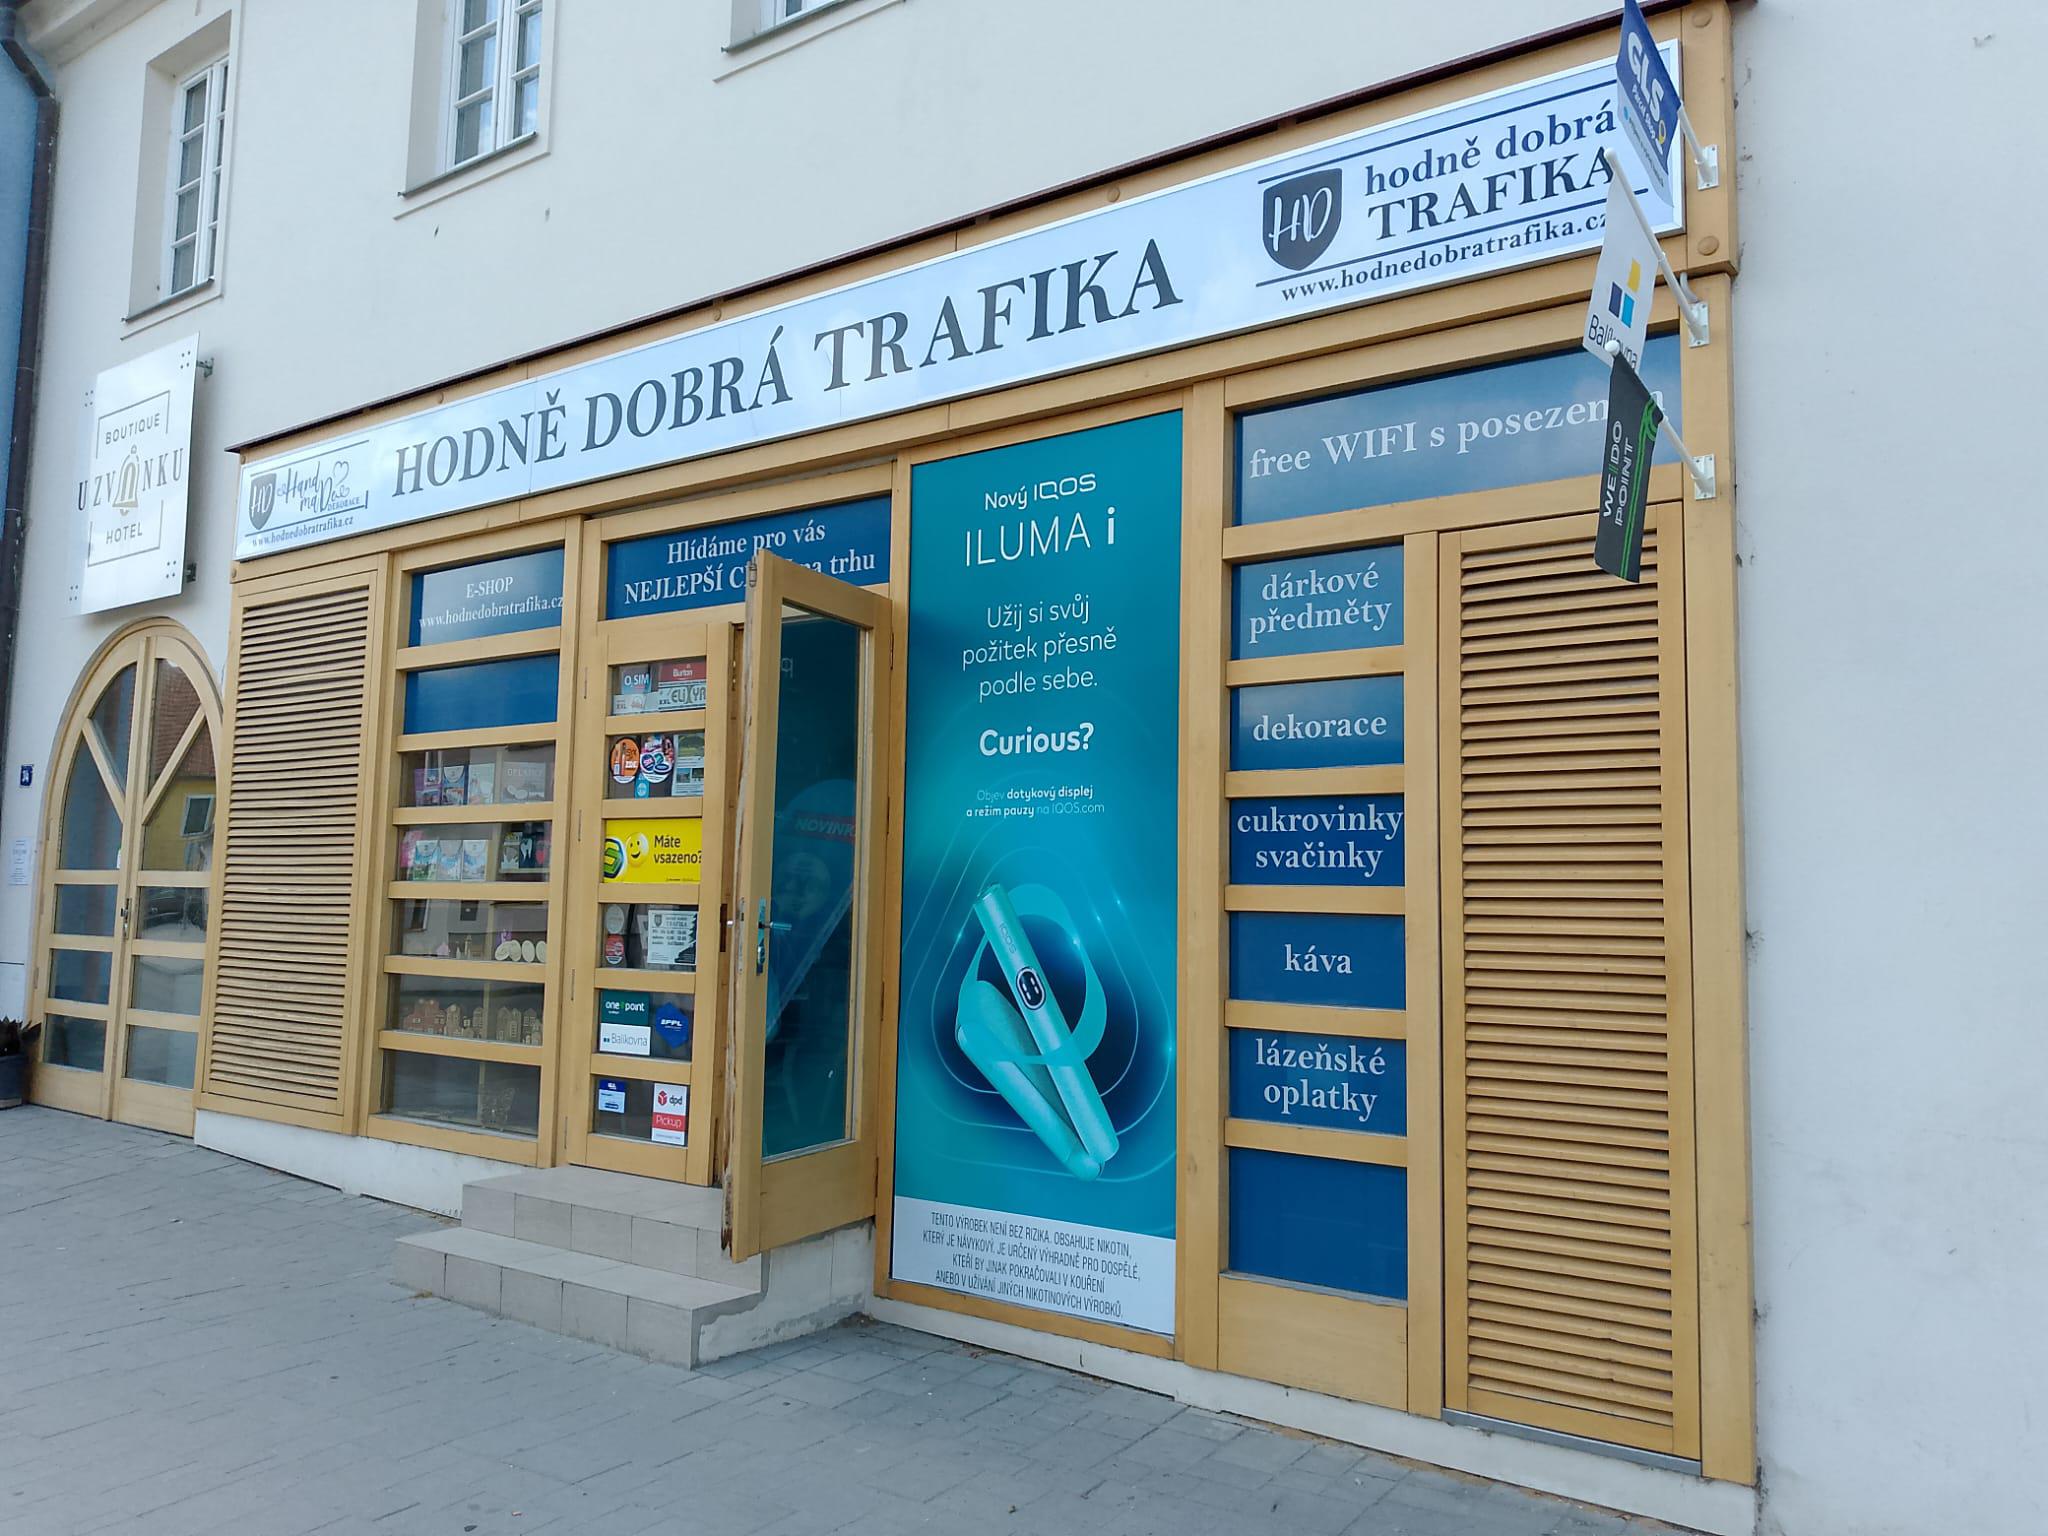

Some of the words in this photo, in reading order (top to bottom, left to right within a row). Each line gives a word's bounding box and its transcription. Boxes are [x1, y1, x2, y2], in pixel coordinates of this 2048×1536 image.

[1628, 31, 1664, 122] GLS
[1365, 137, 1481, 196] hodně
[1495, 99, 1616, 162] dobrá
[1368, 146, 1613, 240] TRAFIKA
[1281, 213, 1605, 301] www.hodnedobratrafika.cz
[392, 388, 566, 497] HODNĚ
[581, 325, 793, 452] DOBRÁ
[814, 238, 1183, 392] TRAFIKA
[105, 412, 160, 445] BOUTIQUE
[1249, 448, 1311, 479] free
[1322, 422, 1416, 465] WIFI
[1430, 426, 1445, 448] s
[1457, 390, 1665, 455] posezen
[985, 485, 1028, 511] Nový
[1034, 473, 1097, 501] IQOS
[1615, 437, 1633, 526] POINT
[105, 521, 143, 545] HOTEL
[667, 536, 748, 565] Hlídáme
[753, 530, 786, 555] pro
[792, 519, 826, 543] vás
[966, 512, 1091, 567] ILUMA
[1107, 506, 1116, 545] i
[466, 576, 514, 599] E-SHOP
[624, 562, 722, 605] NEJLEPŠÍ
[830, 549, 876, 575] trhu
[1261, 562, 1380, 601] dárkové
[418, 595, 564, 628] www.hodnedobratrafika.cz
[987, 603, 1023, 632] Užij
[1028, 601, 1043, 623] si
[1049, 593, 1090, 624] svůj
[1249, 599, 1392, 644] předměty
[962, 635, 1038, 672] požitek
[1044, 625, 1117, 663] přesně
[979, 670, 1036, 704] podle
[1042, 665, 1098, 691] sebe.
[979, 722, 1095, 757] Curious?
[1253, 713, 1387, 741] dekorace
[966, 808, 973, 817] a
[975, 805, 1002, 817] režim
[1003, 806, 1035, 819] pauzy
[1006, 786, 1056, 802] dotykový
[1057, 784, 1094, 800] displej
[654, 834, 681, 849] Máte
[1237, 803, 1404, 841] cukrovinky
[653, 850, 703, 865] vsazeno?
[1255, 840, 1384, 878] svačinky
[1284, 943, 1352, 974] káva
[625, 1002, 645, 1013] point
[1255, 1038, 1386, 1075] lázeňské
[669, 1095, 683, 1106] dpd
[1263, 1078, 1378, 1122] oplatky
[922, 1229, 945, 1244] KTERÝ
[946, 1233, 955, 1247] JE
[997, 1242, 1006, 1255] JE
[1008, 1242, 1038, 1261] URČENÝ
[1039, 1247, 1080, 1269] VÝHRADNĚ
[1082, 1256, 1099, 1272] PRO
[931, 1211, 954, 1228] TENTO
[955, 1213, 988, 1233] VÝROBEK
[989, 1220, 1008, 1236] NENÍ
[1009, 1224, 1024, 1239] BEZ
[1054, 1231, 1095, 1252] OBSAHUJE
[935, 1269, 960, 1286] ANEBO
[961, 1274, 967, 1287] V
[997, 1280, 1024, 1298] JINÝCH
[1026, 1285, 1082, 1311] NIKOTINOVÝCH
[952, 1252, 973, 1269] KTEŘÍ
[975, 1257, 985, 1271] BY
[986, 1259, 1008, 1275] JINAK
[1009, 1263, 1061, 1285] POKRAČOVALI
[1063, 1273, 1069, 1287] V
[1070, 1274, 1105, 1294] KOUŘENÍ
